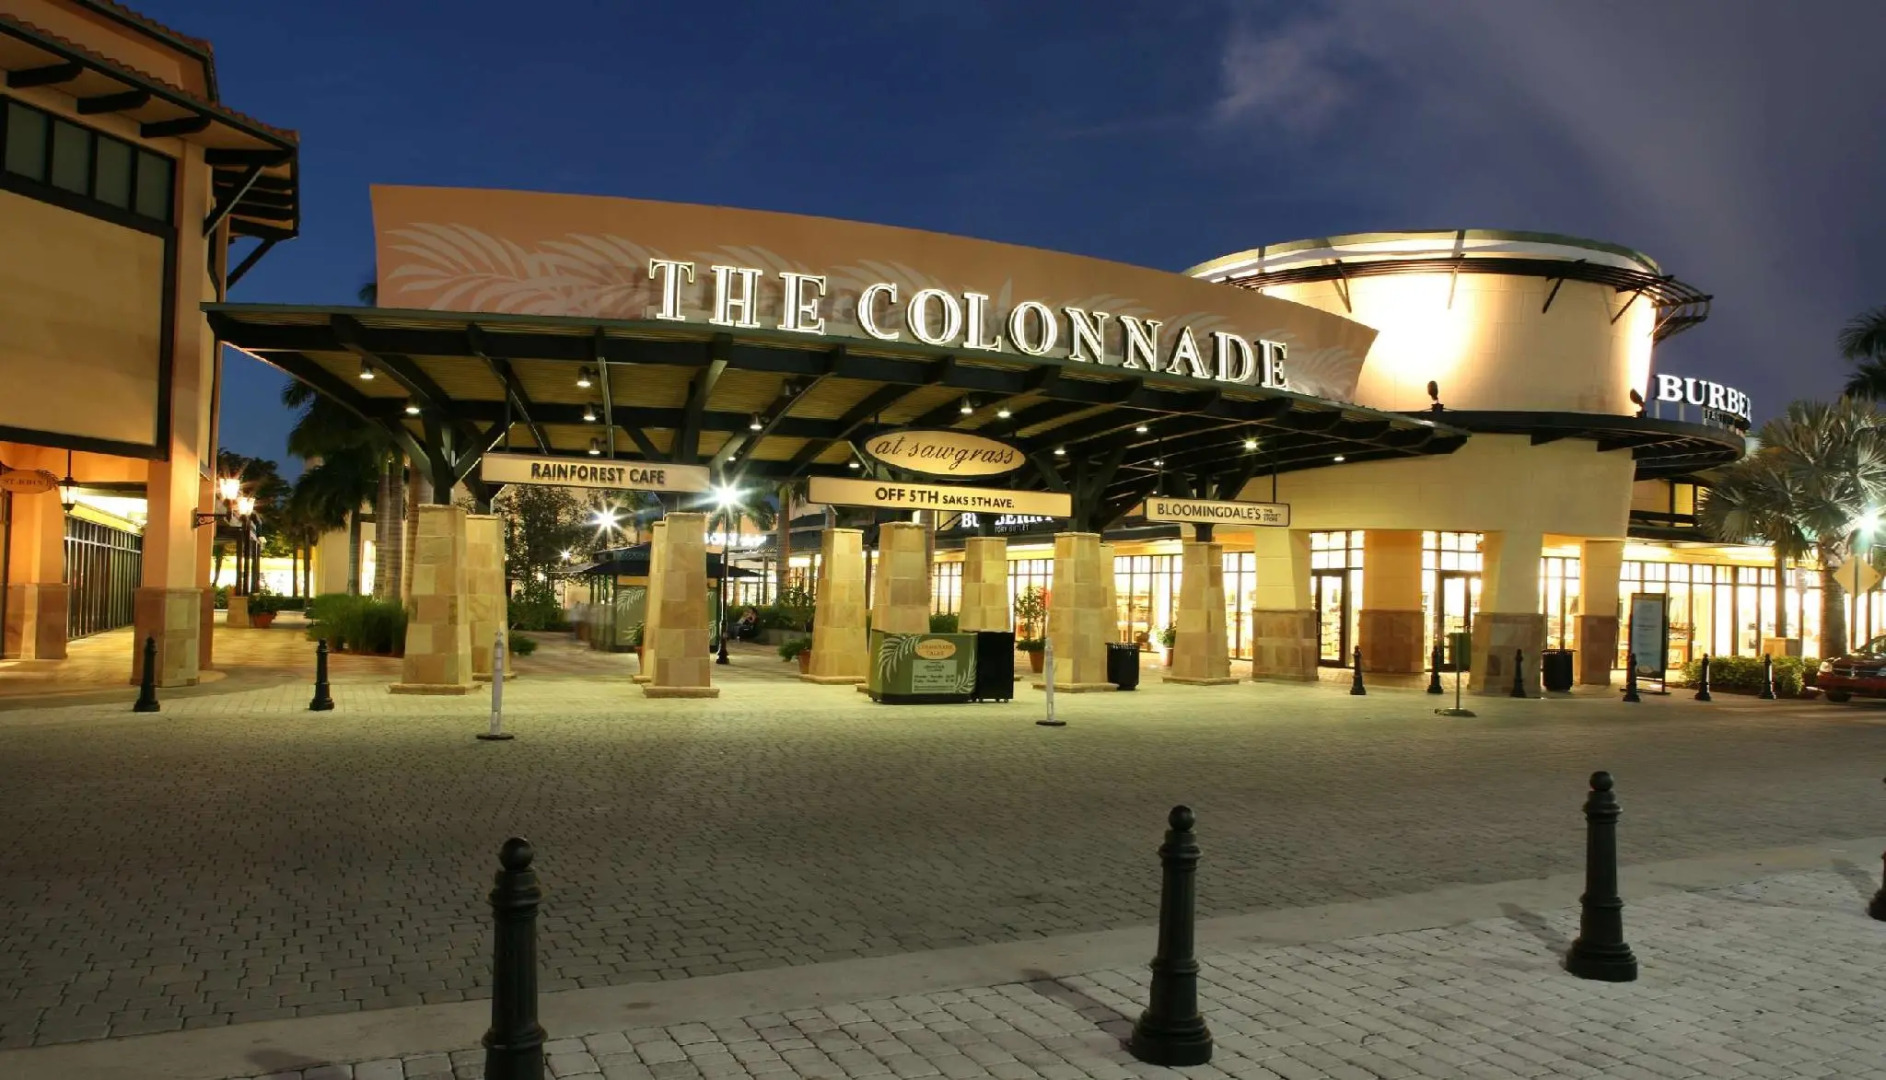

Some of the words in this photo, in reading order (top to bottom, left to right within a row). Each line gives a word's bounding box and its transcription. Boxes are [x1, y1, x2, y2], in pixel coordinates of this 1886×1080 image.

[649, 257, 827, 336] THE
[856, 282, 1290, 391] COLONNADE
[874, 436, 906, 455] at
[907, 441, 1015, 471] sawgrass
[531, 462, 625, 483] RAINFOREST
[629, 468, 665, 485] CAFE
[875, 487, 906, 502] OFF
[909, 490, 939, 504] 5TH
[942, 494, 969, 506] SAKS
[971, 496, 991, 508] 5TH
[993, 498, 1015, 509] AVE.
[1157, 503, 1261, 521] BLOOMINGDALE'S
